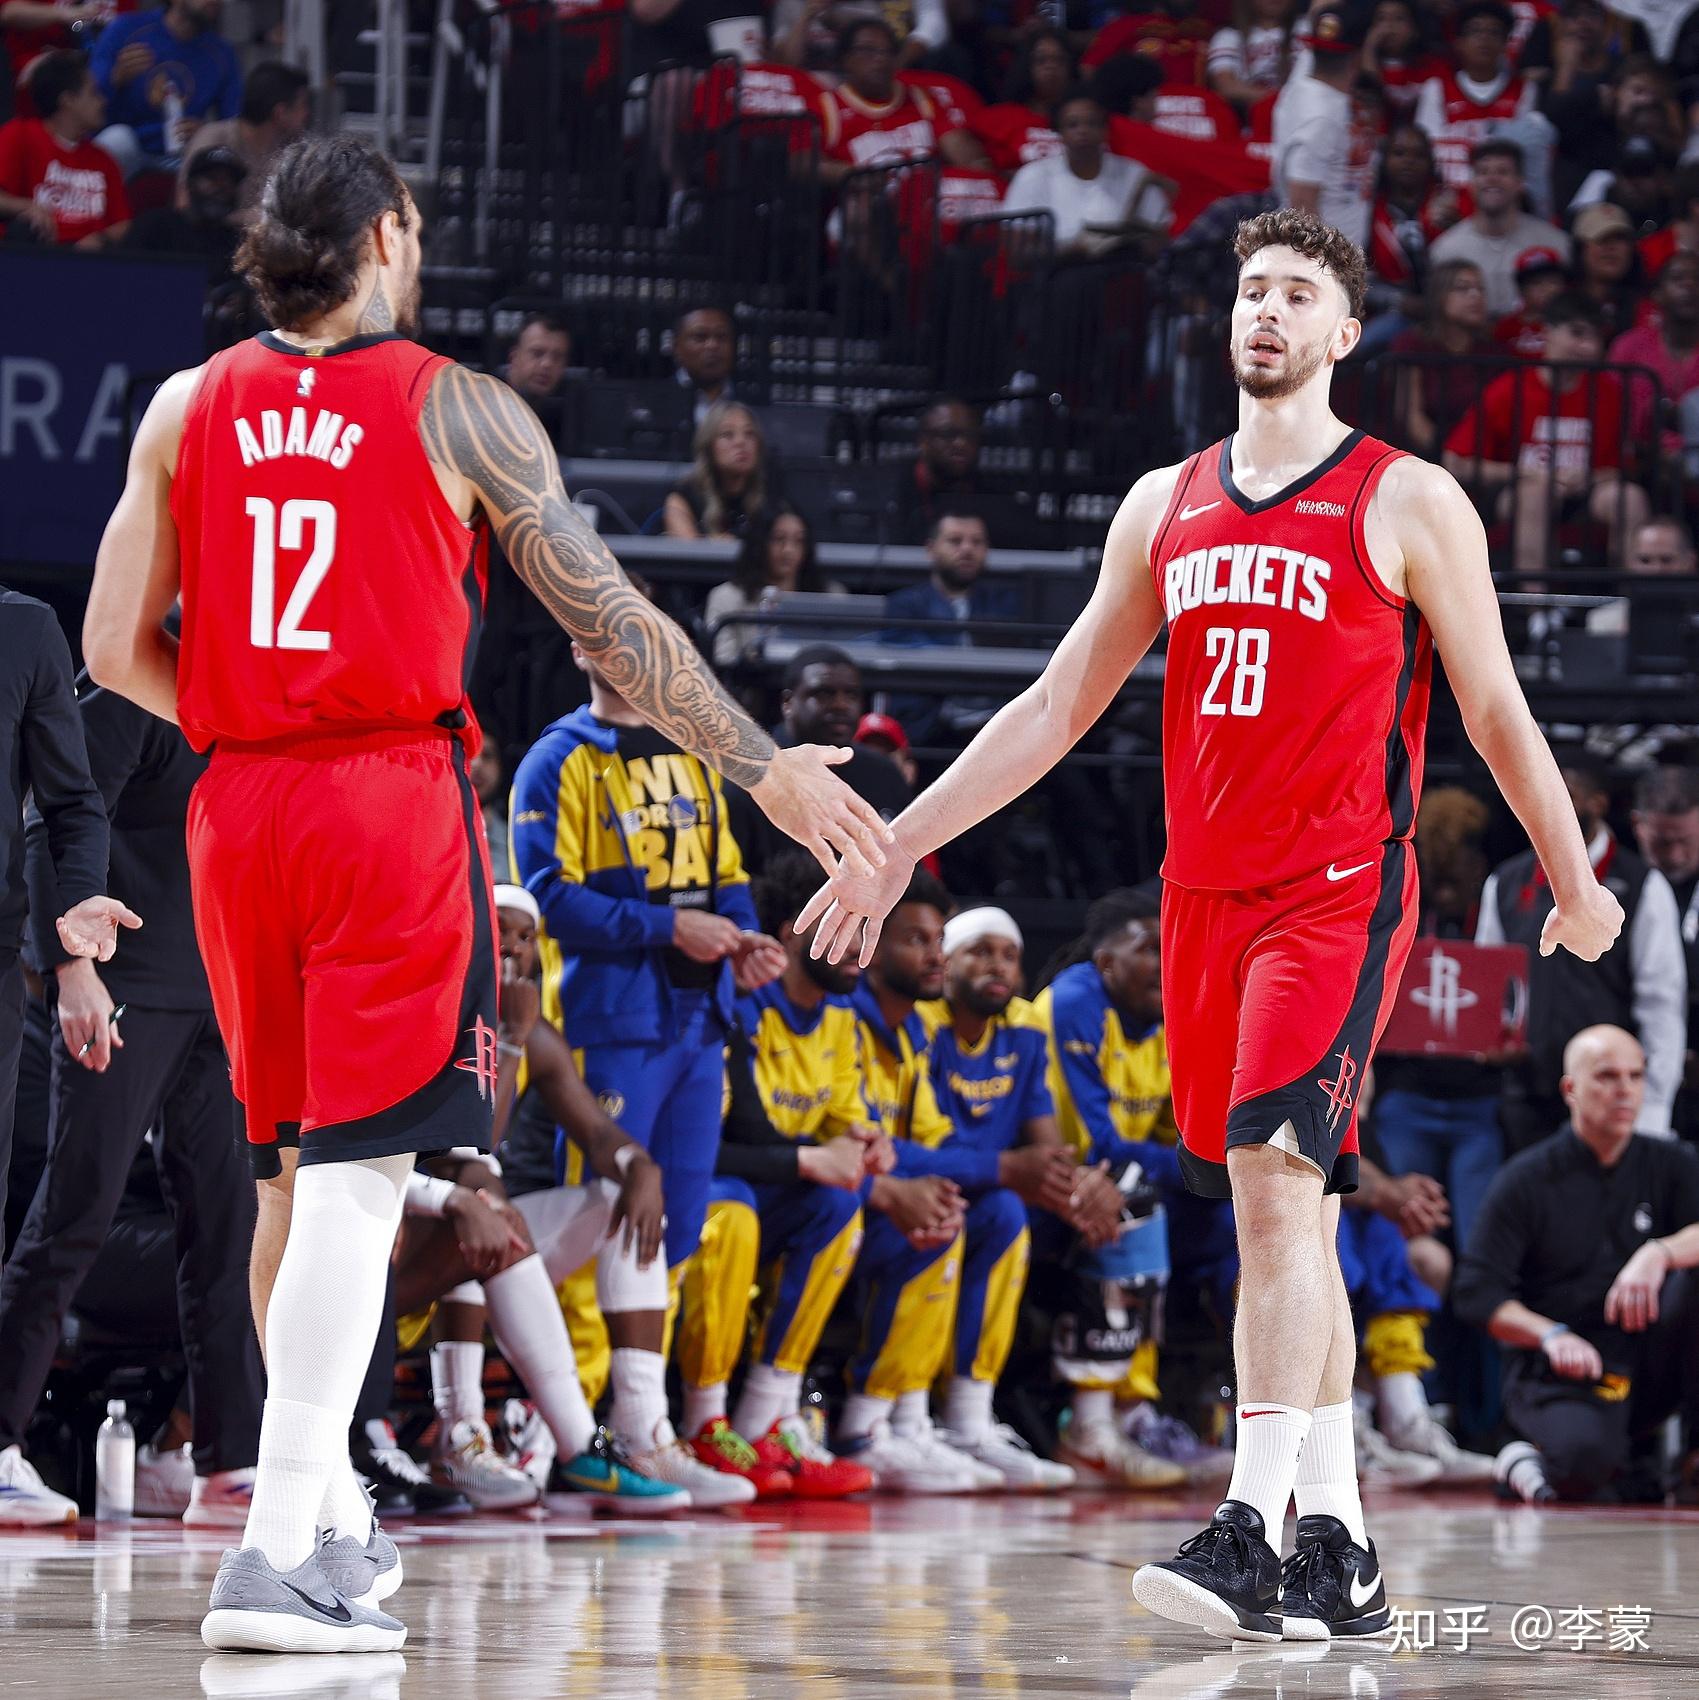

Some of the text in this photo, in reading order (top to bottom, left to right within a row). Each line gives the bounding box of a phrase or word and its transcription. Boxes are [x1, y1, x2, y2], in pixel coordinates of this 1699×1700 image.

[233, 406, 366, 471] ADAMS
[245, 496, 338, 651] 12
[1164, 543, 1332, 623] ROCKETS
[1200, 627, 1271, 718] 28
